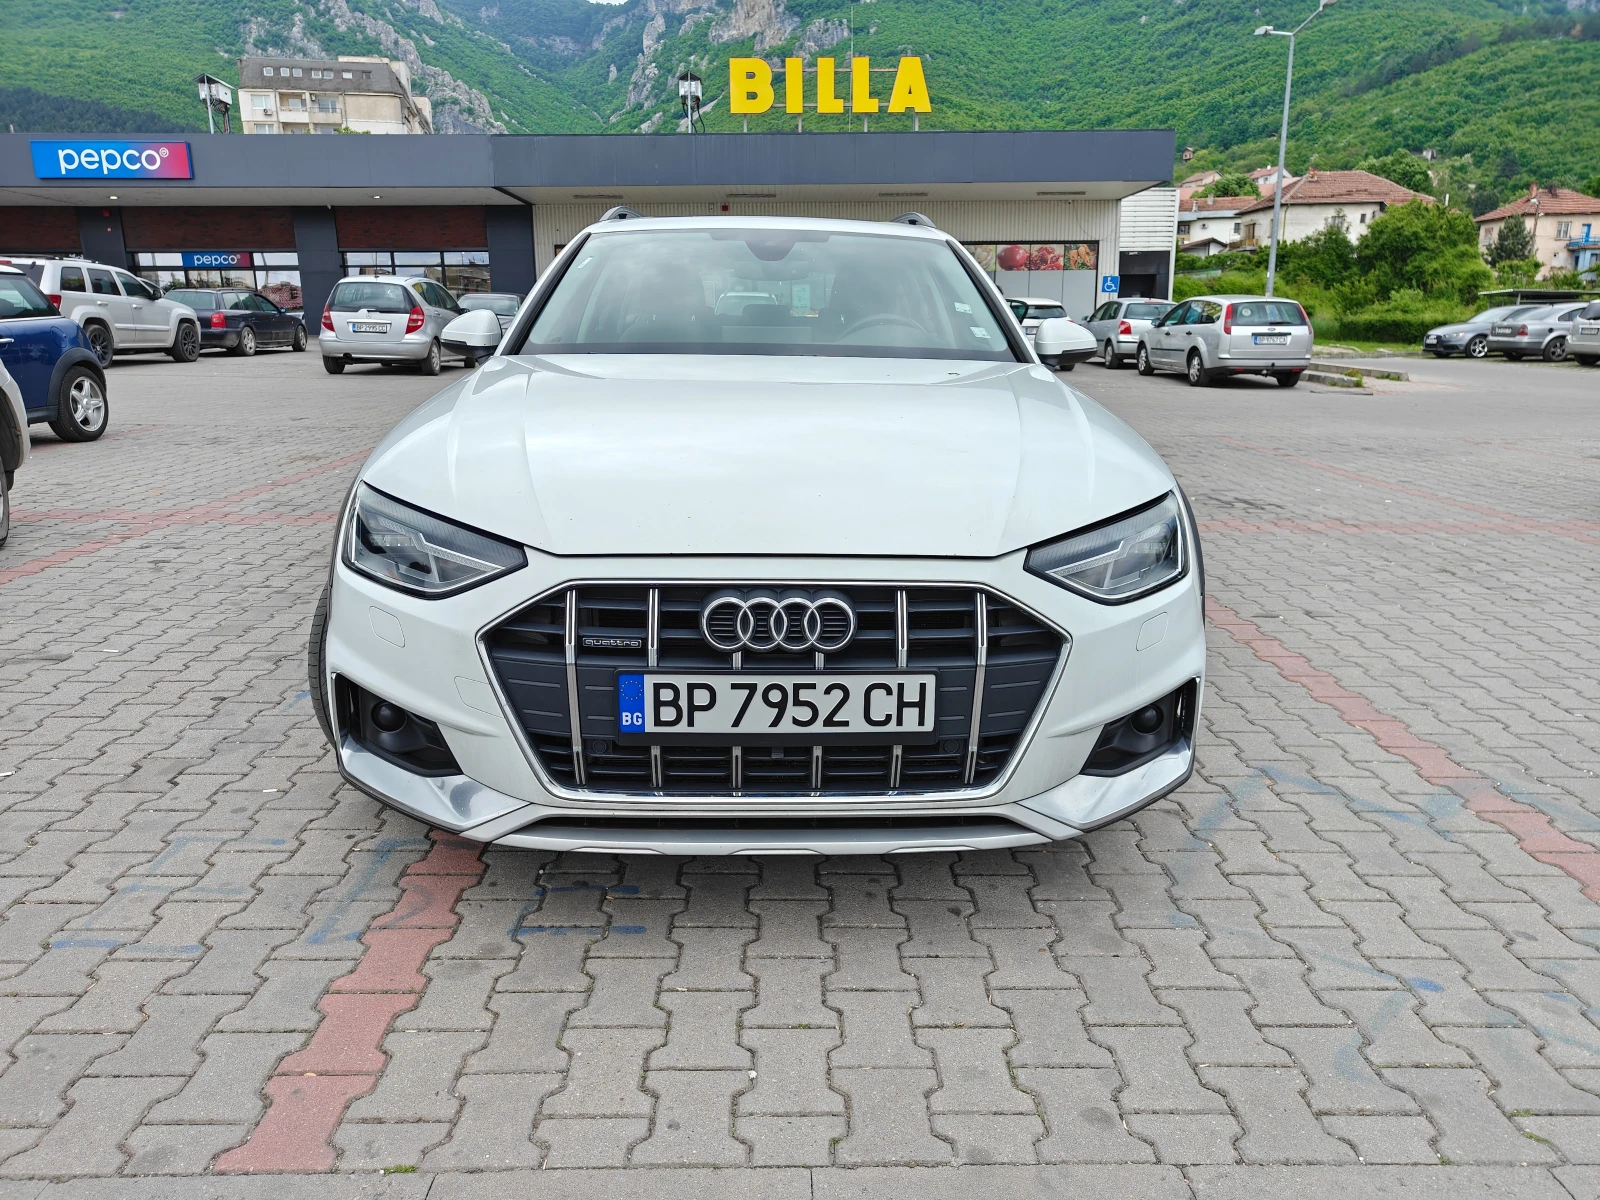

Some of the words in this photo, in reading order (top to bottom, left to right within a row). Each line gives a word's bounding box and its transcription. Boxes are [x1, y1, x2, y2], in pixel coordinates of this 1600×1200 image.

[728, 56, 932, 114] BILLA
[57, 148, 161, 175] pepco
[193, 254, 238, 267] pepco
[652, 682, 717, 727] BP
[730, 682, 851, 728] 7952
[863, 682, 927, 727] CH
[622, 712, 643, 726] BG
